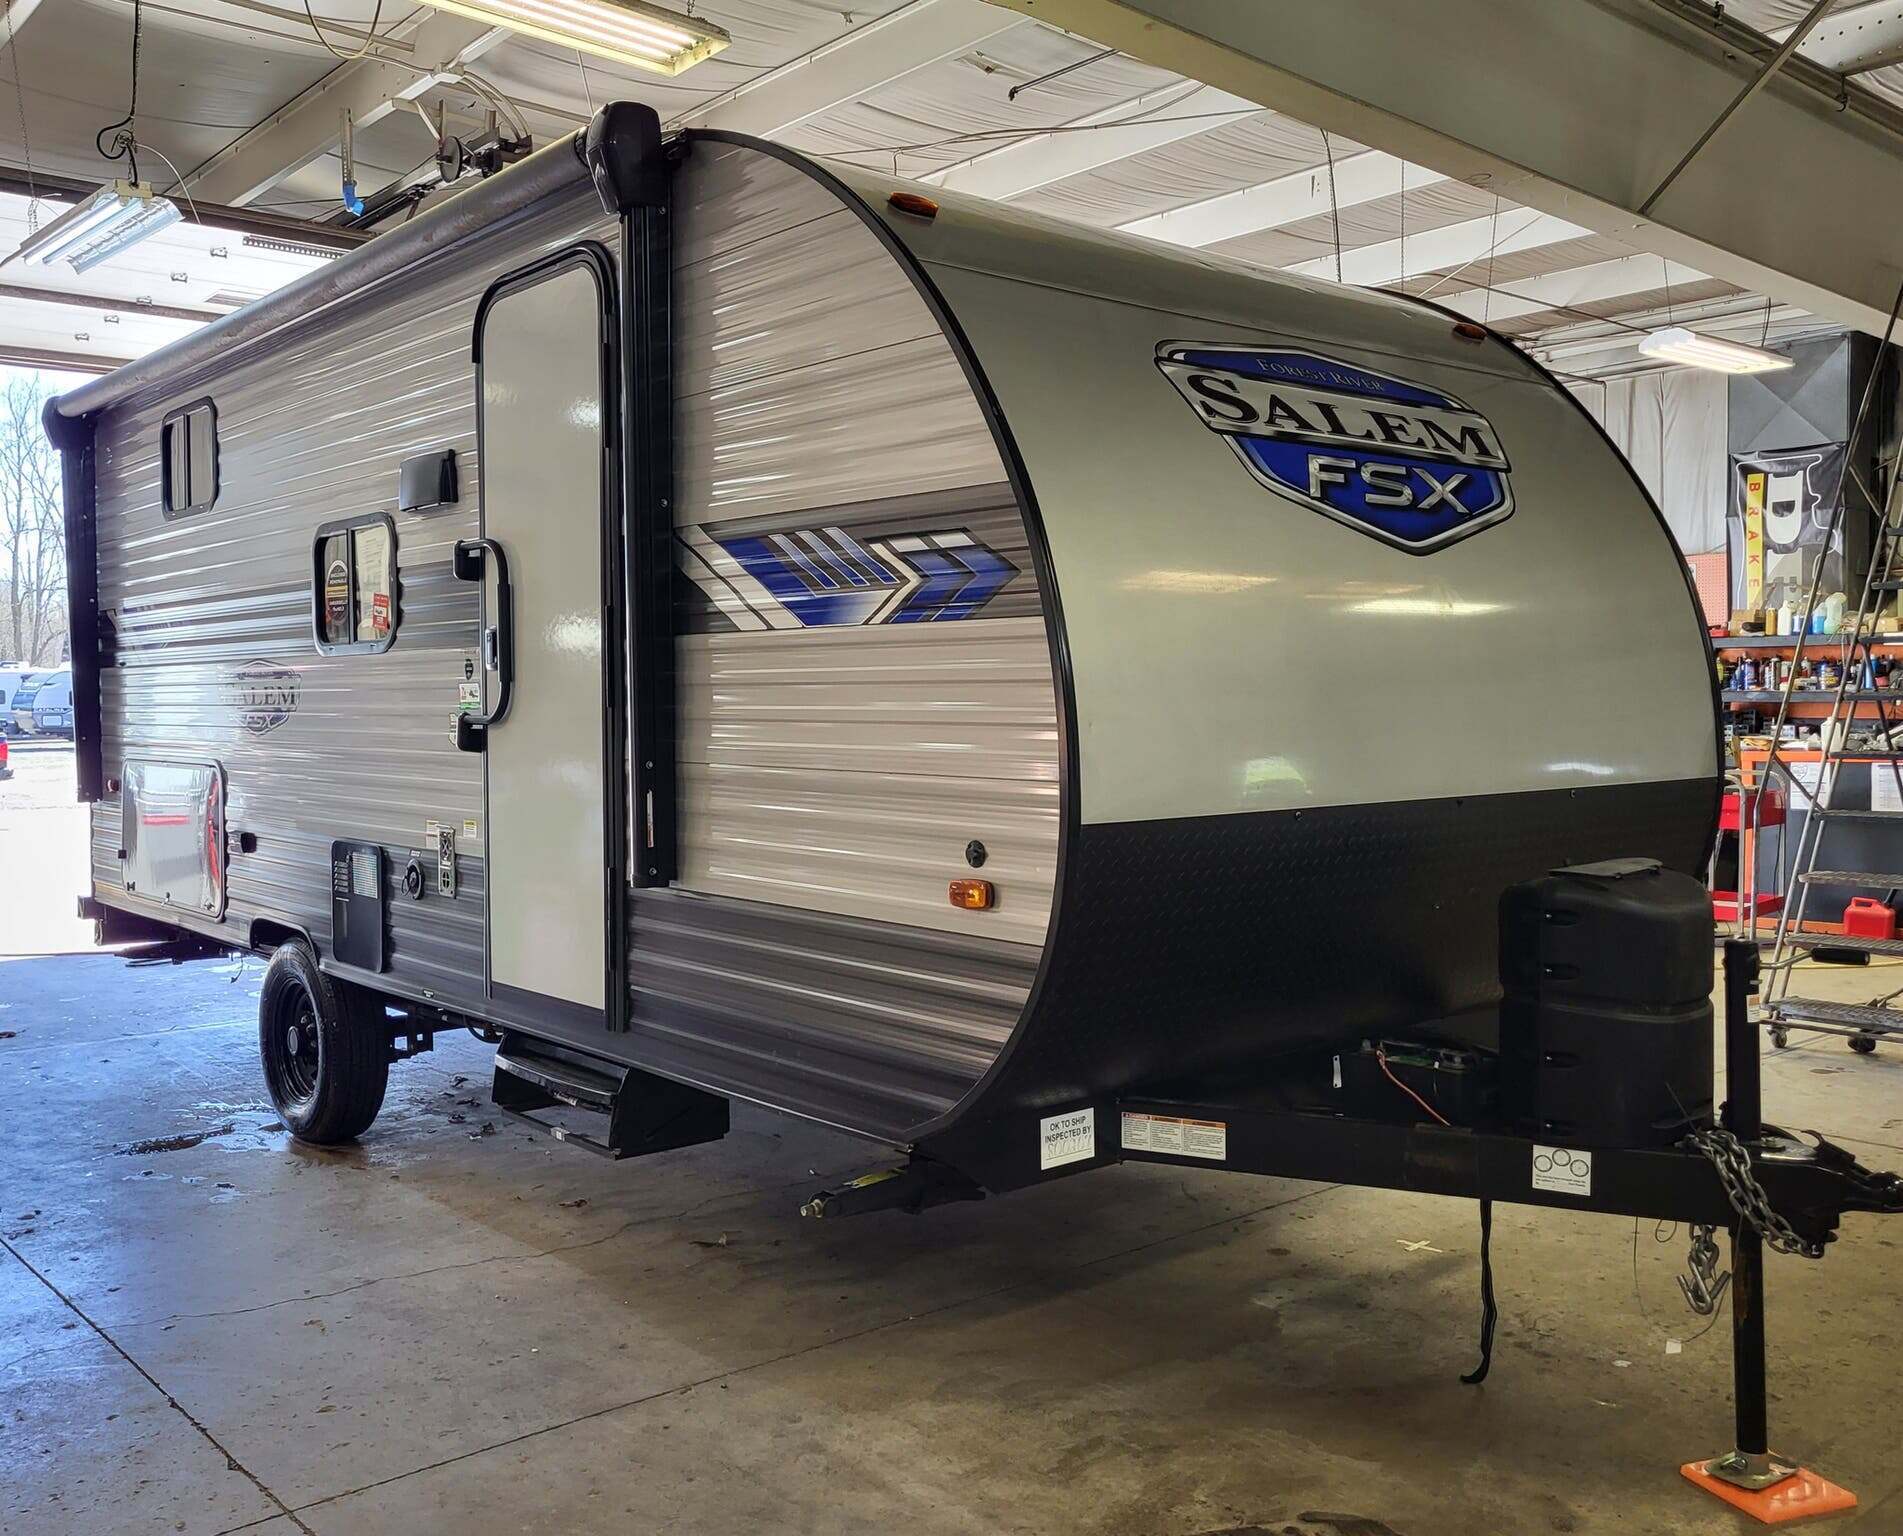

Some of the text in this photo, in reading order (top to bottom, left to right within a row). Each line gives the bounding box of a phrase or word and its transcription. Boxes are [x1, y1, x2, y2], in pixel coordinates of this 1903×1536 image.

[1256, 358, 1385, 392] FOREST RIVER
[1187, 374, 1499, 460] SALEM
[1307, 453, 1471, 515] FSX
[1045, 1124, 1092, 1143] INSPECTED BY
[1050, 1115, 1086, 1132] OK TO SHIP
